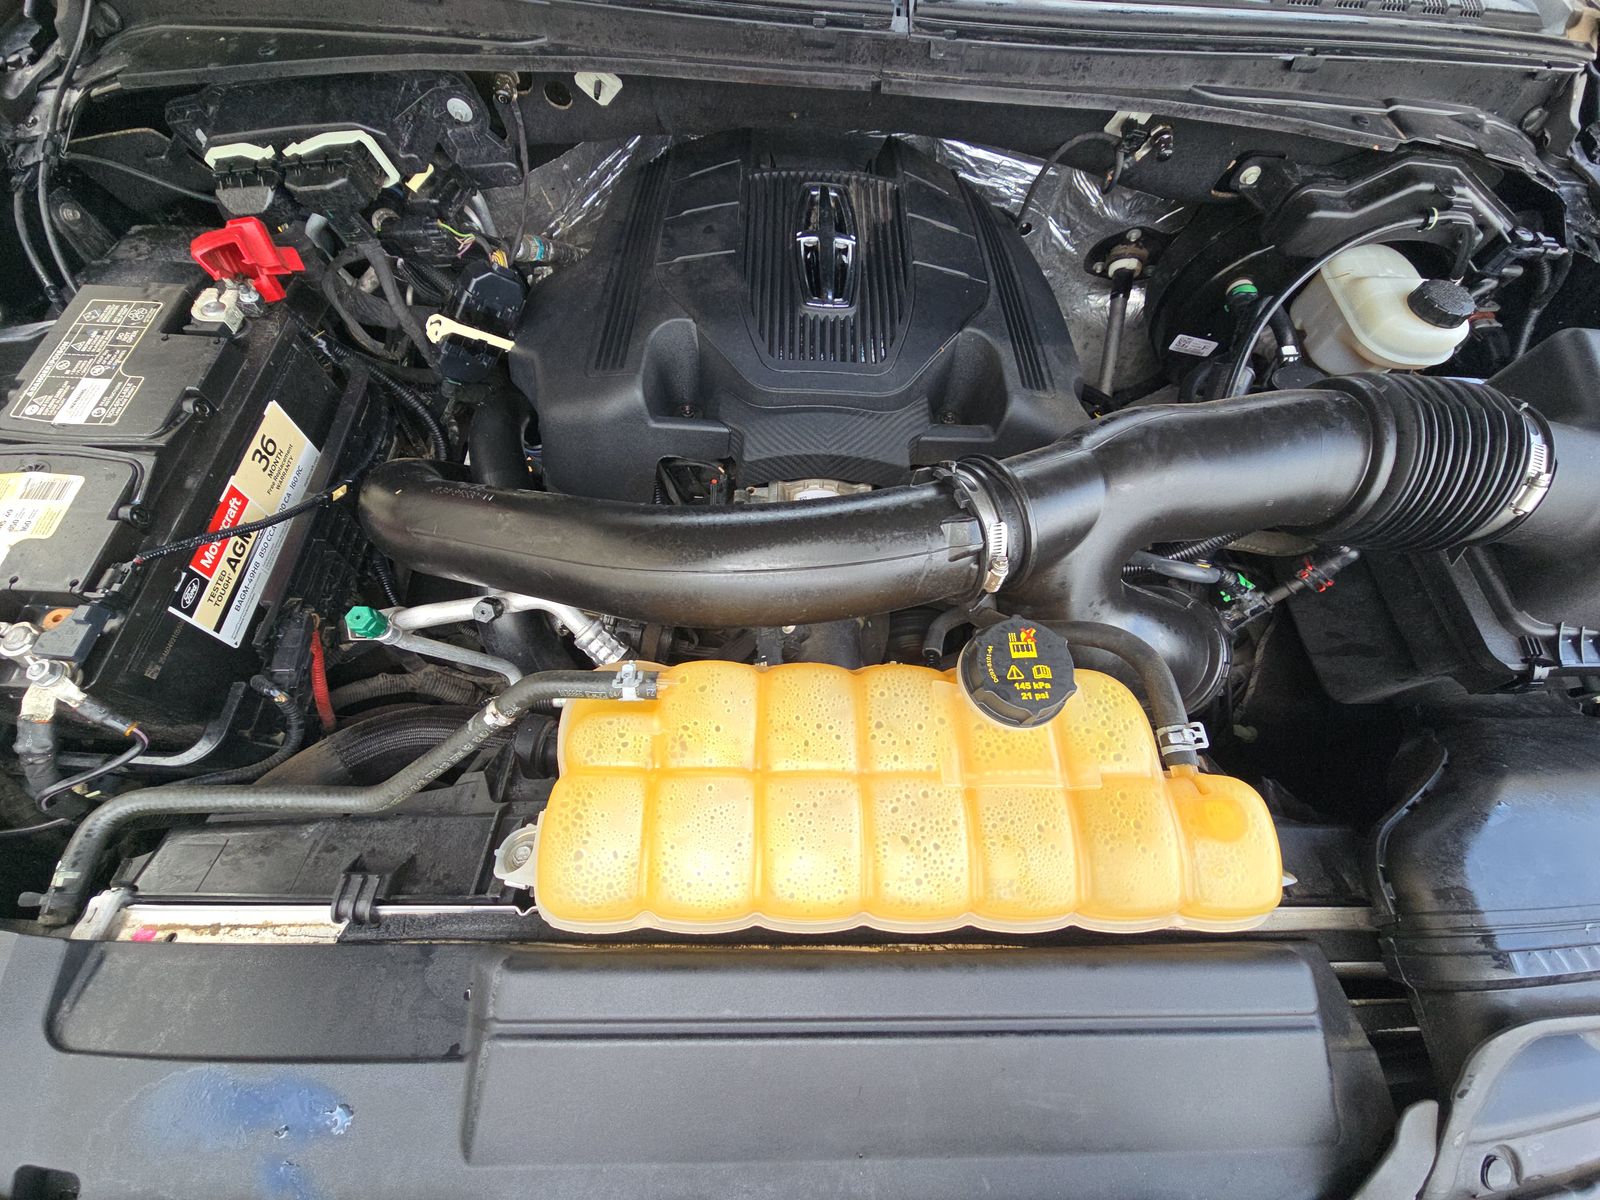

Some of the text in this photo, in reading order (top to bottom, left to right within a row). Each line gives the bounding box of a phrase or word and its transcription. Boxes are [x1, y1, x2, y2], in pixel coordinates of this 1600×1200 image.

[120, 331, 131, 341] NOT
[251, 433, 277, 473] 36
[266, 448, 284, 479] MONTH
[266, 442, 293, 496] Free Replacement
[275, 454, 294, 491] WARRANTY
[257, 540, 268, 559] 850
[265, 523, 276, 542] CCA
[283, 490, 291, 504] CA
[289, 473, 299, 490] 160
[295, 464, 303, 477] RC
[200, 496, 242, 569] Motcraft
[182, 582, 199, 605] Ford
[206, 568, 227, 605] TESTED
[1014, 681, 1052, 690] 145 kPa
[1020, 691, 1050, 702] 21 psi
